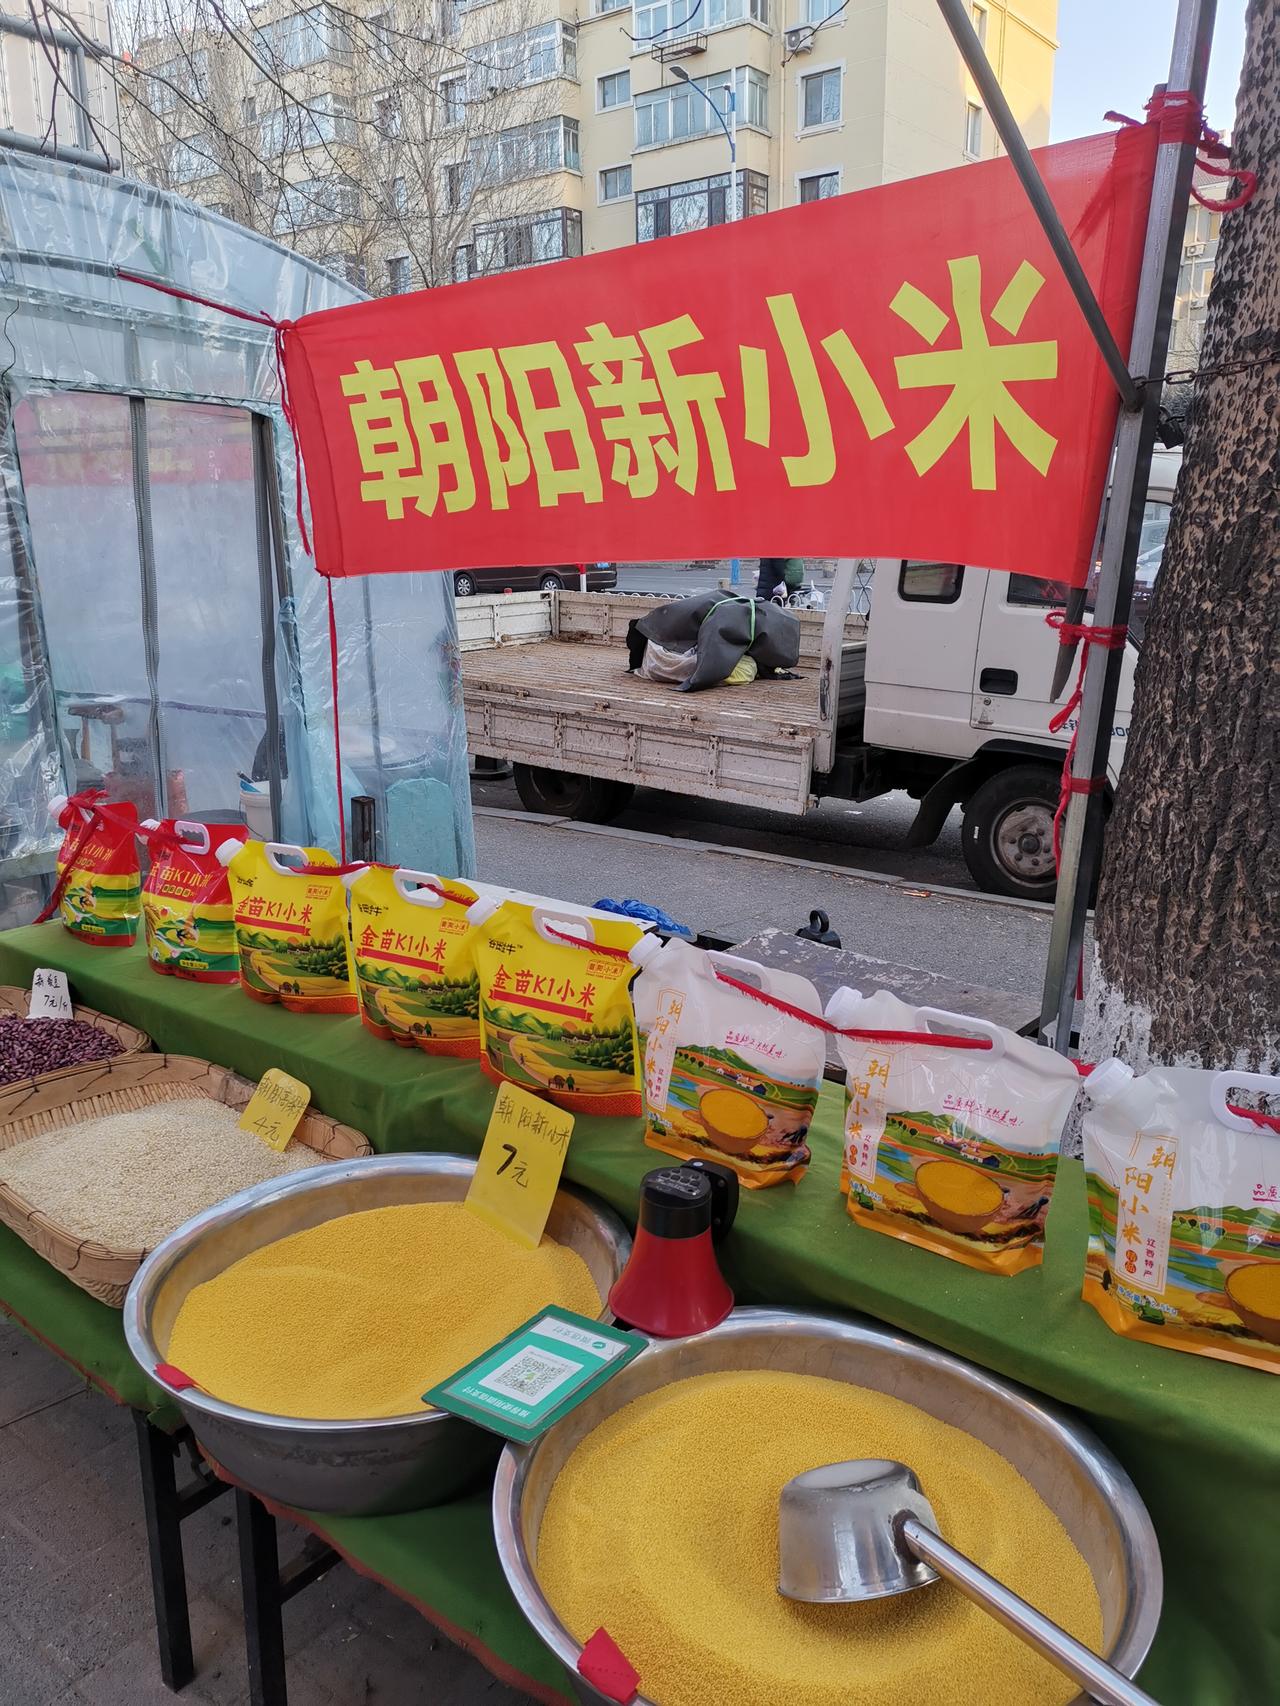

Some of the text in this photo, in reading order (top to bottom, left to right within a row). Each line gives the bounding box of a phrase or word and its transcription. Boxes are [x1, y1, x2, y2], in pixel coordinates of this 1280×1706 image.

[340, 255, 1059, 520] 朝阳新小米
[236, 896, 313, 925] 金苗K1小米
[360, 925, 448, 961] 金苗K1小米
[493, 964, 596, 1008] 金苗K1小米
[849, 1058, 891, 1140] 朝阳小米
[253, 1116, 281, 1141] 4元
[496, 1143, 529, 1188] 7元
[1120, 1145, 1177, 1246] 朝阳小米
[1143, 1238, 1156, 1277] 辽西特产
[463, 1386, 531, 1418] 推荐使用微信支付
